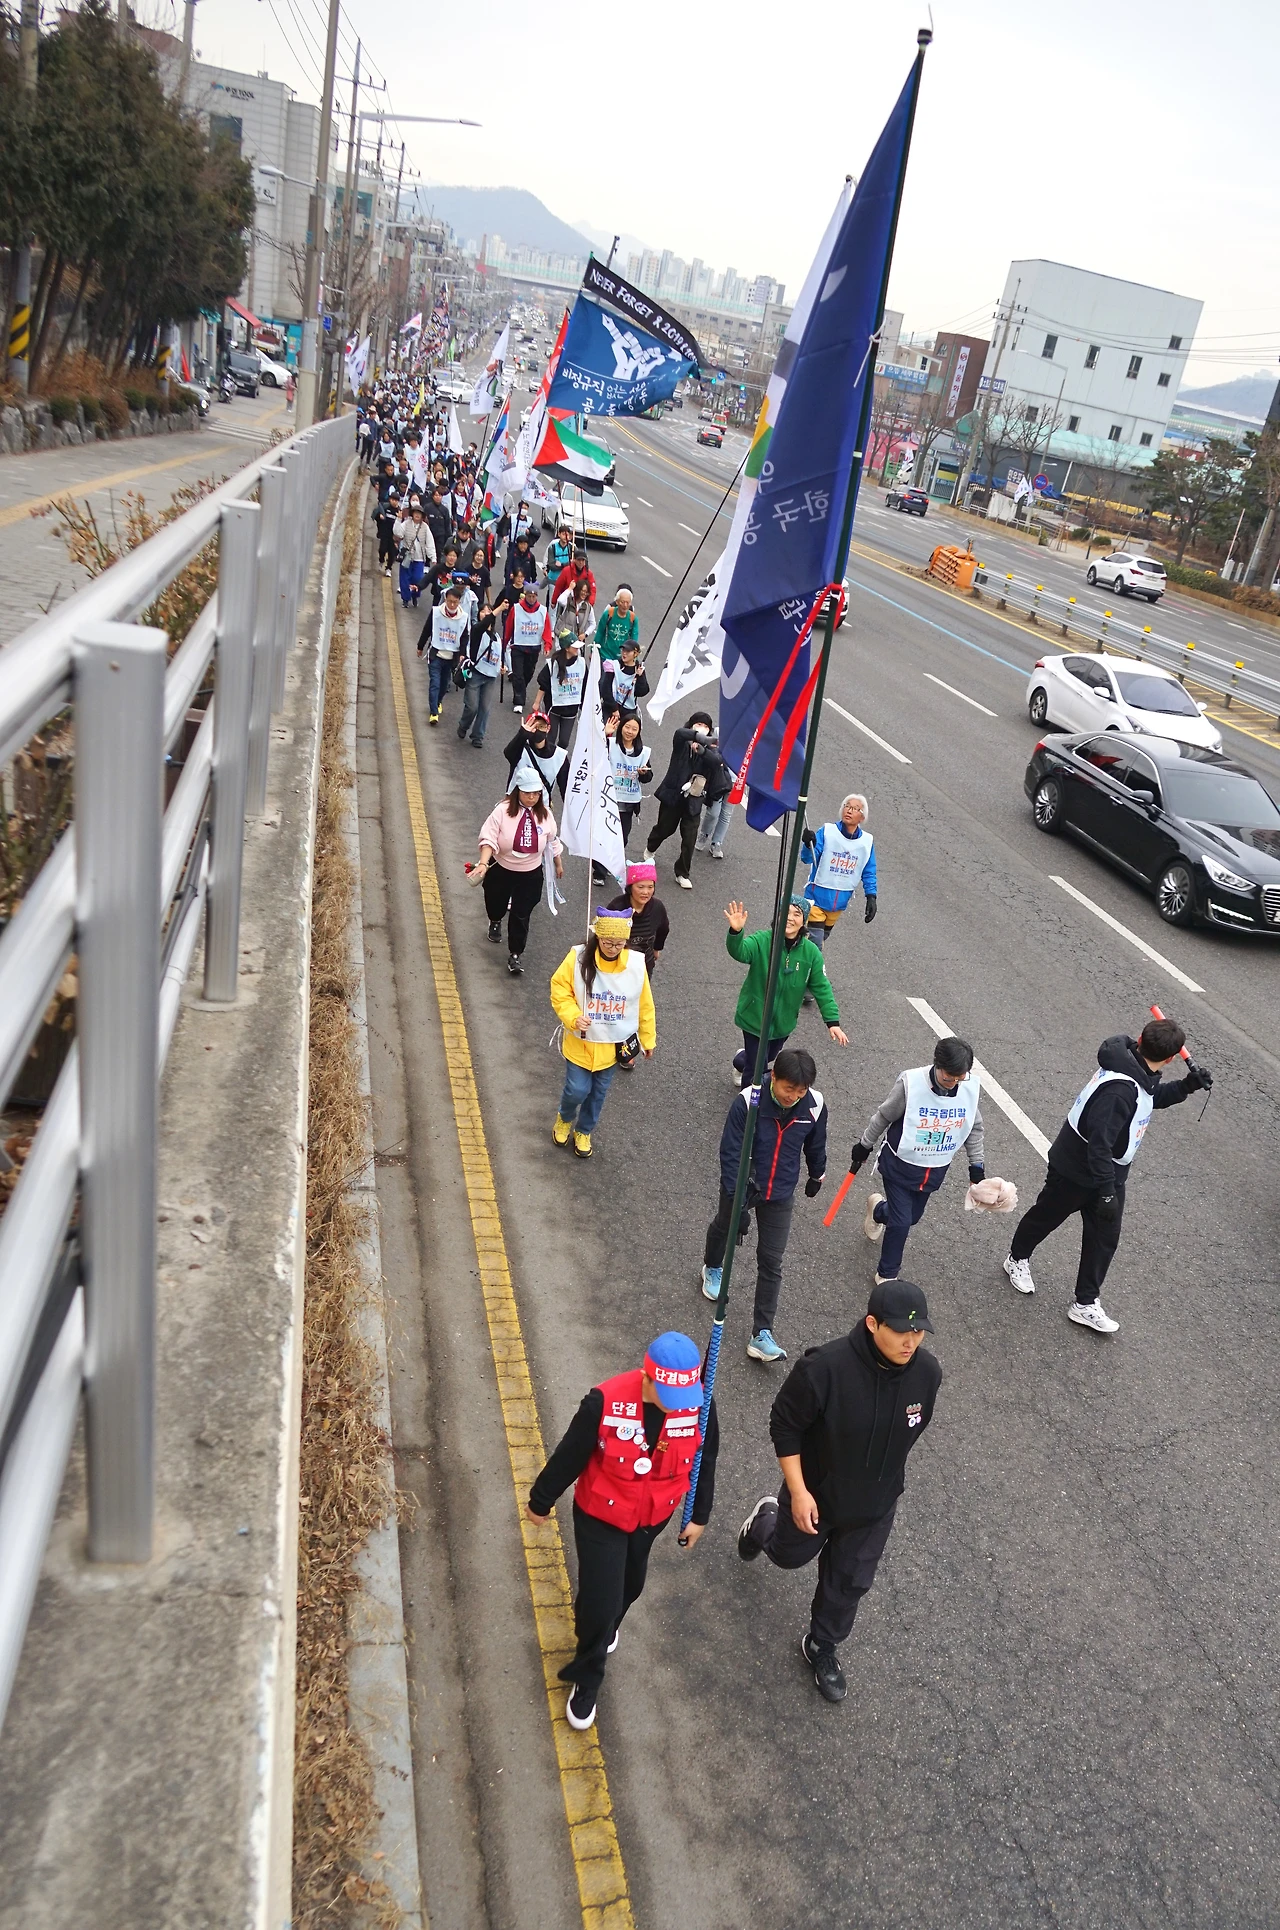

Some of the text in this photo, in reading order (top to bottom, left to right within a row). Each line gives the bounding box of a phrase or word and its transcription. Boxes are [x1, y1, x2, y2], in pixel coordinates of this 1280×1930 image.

[616, 286, 654, 319] FORGET
[562, 367, 606, 397] 비정규직
[606, 384, 628, 400] 없는
[615, 769, 637, 781] 고용승
[831, 857, 857, 869] 이겨서
[588, 999, 625, 1015] 이겨서
[919, 1106, 967, 1119] 한국옵티칼
[916, 1116, 967, 1133] 고용승계
[936, 1142, 957, 1152] 나서라
[655, 1367, 678, 1385] 단결
[612, 1401, 637, 1417] 단결
